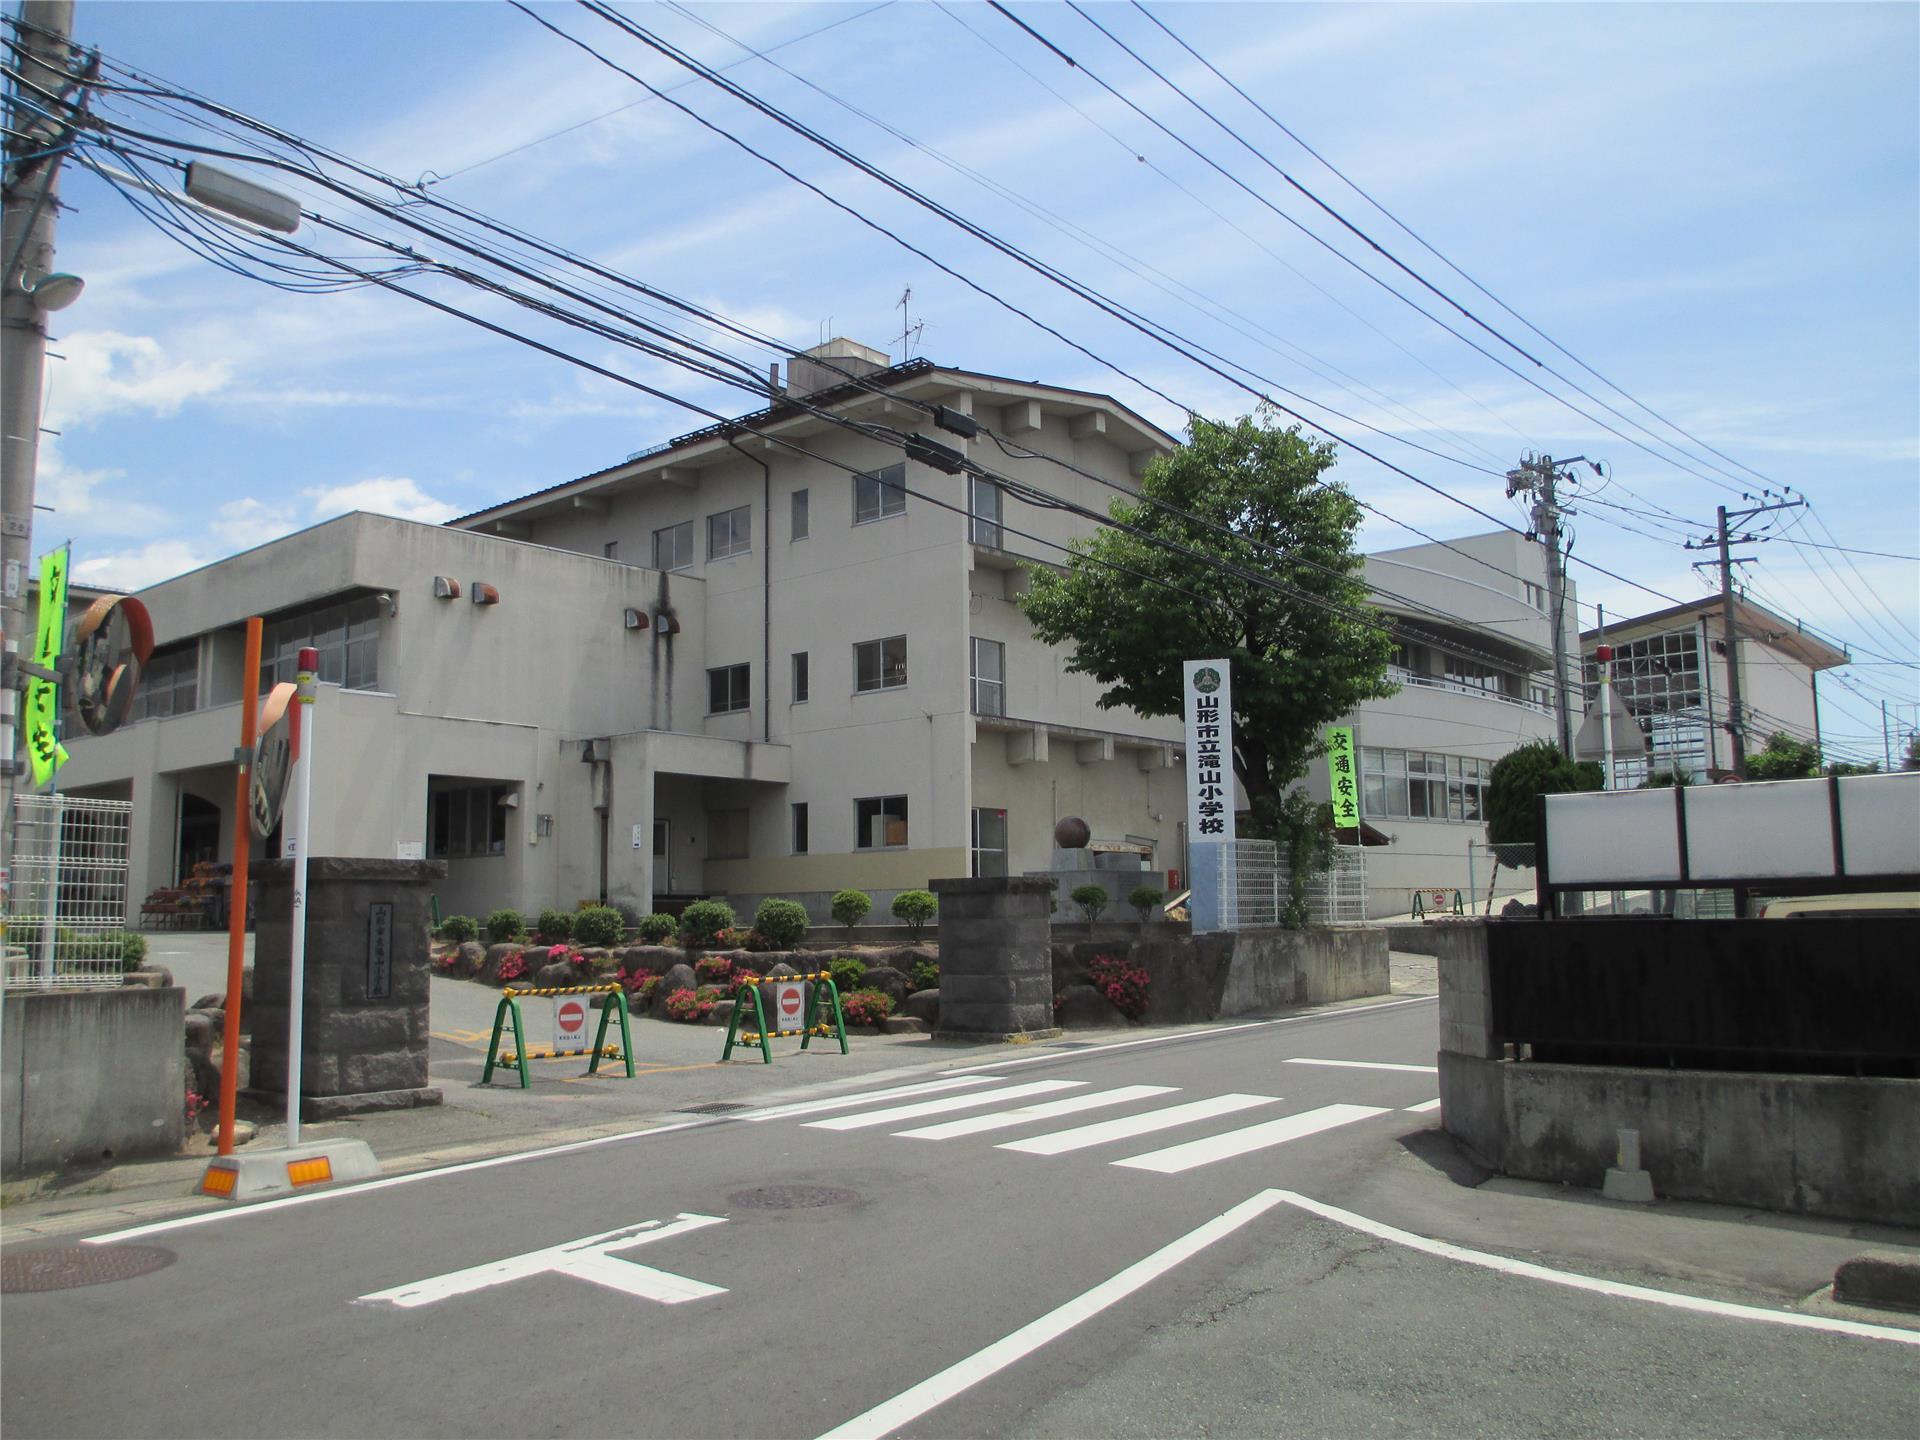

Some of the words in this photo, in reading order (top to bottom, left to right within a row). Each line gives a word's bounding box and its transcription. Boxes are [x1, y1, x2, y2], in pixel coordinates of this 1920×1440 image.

[1197, 695, 1224, 834] 山形市立滝山小学校
[1332, 732, 1355, 818] 交通安全
